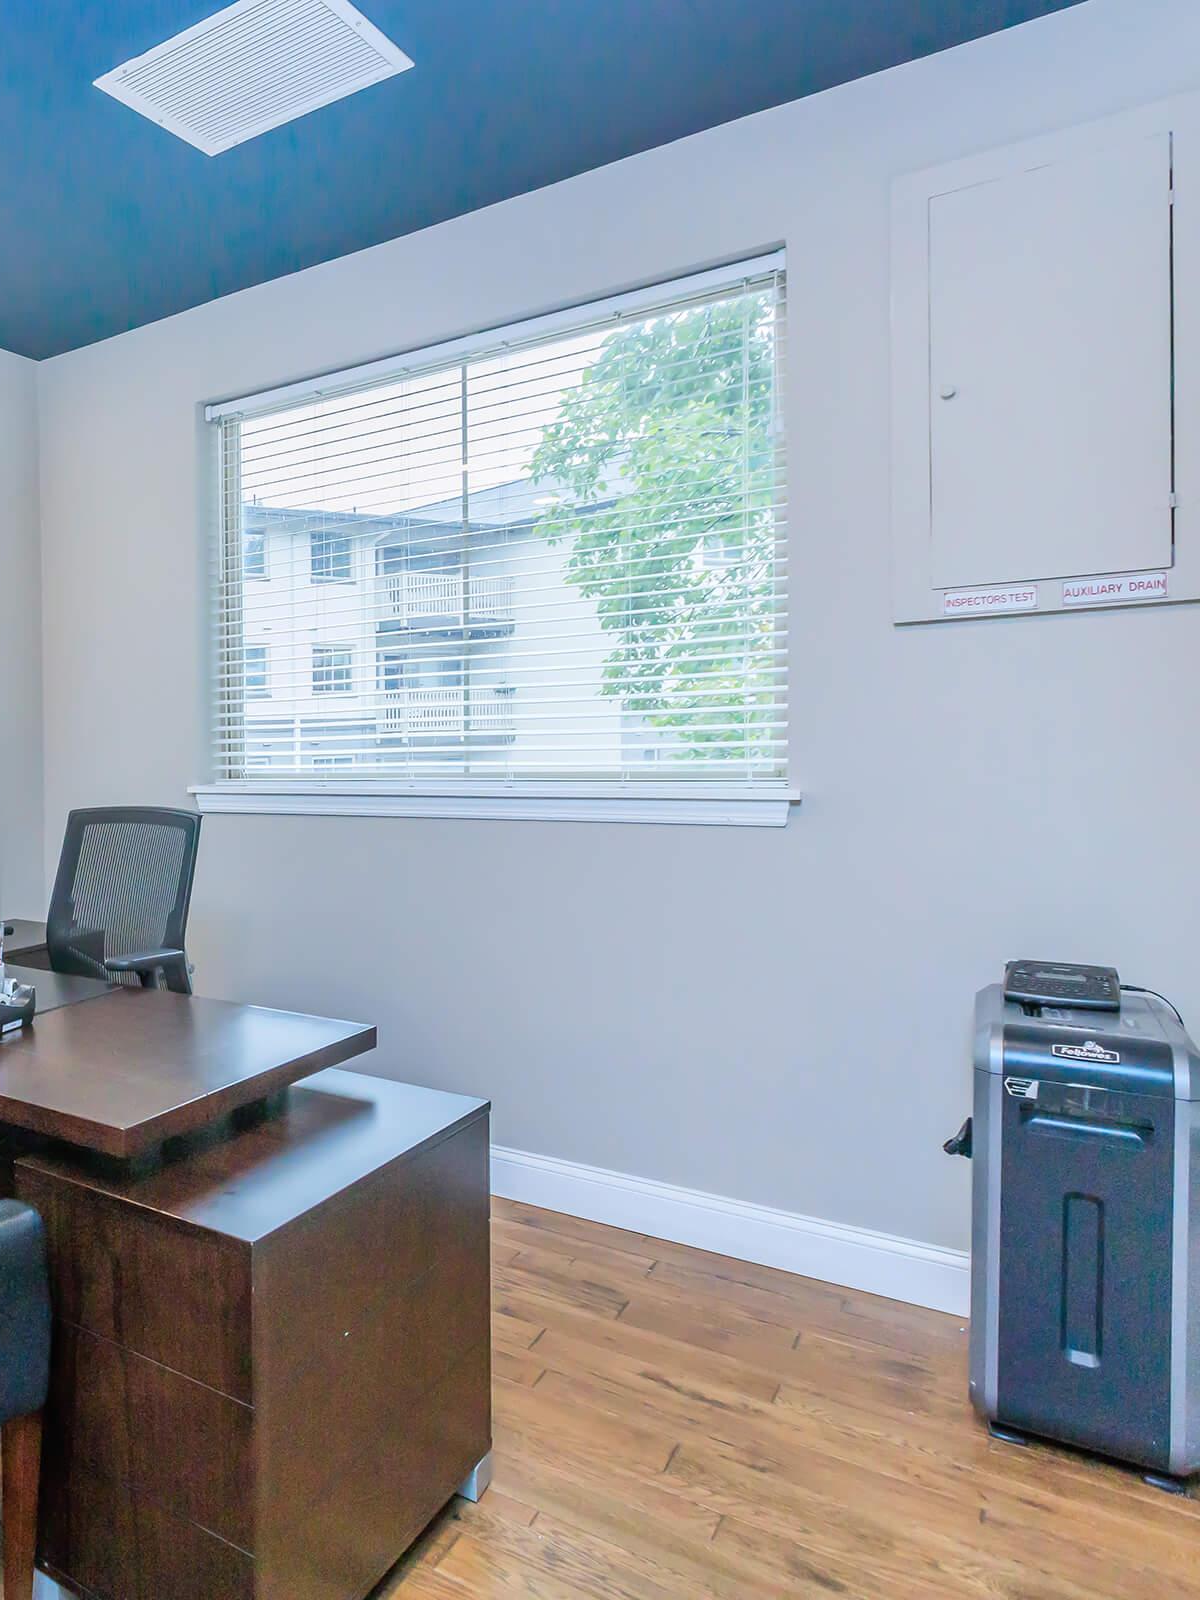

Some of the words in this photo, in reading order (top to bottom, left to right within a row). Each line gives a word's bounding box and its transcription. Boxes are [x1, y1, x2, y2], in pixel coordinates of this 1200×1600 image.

[1064, 584, 1122, 597] AUXILIARY
[1129, 580, 1165, 592] DRAIN
[1008, 591, 1034, 602] TEST
